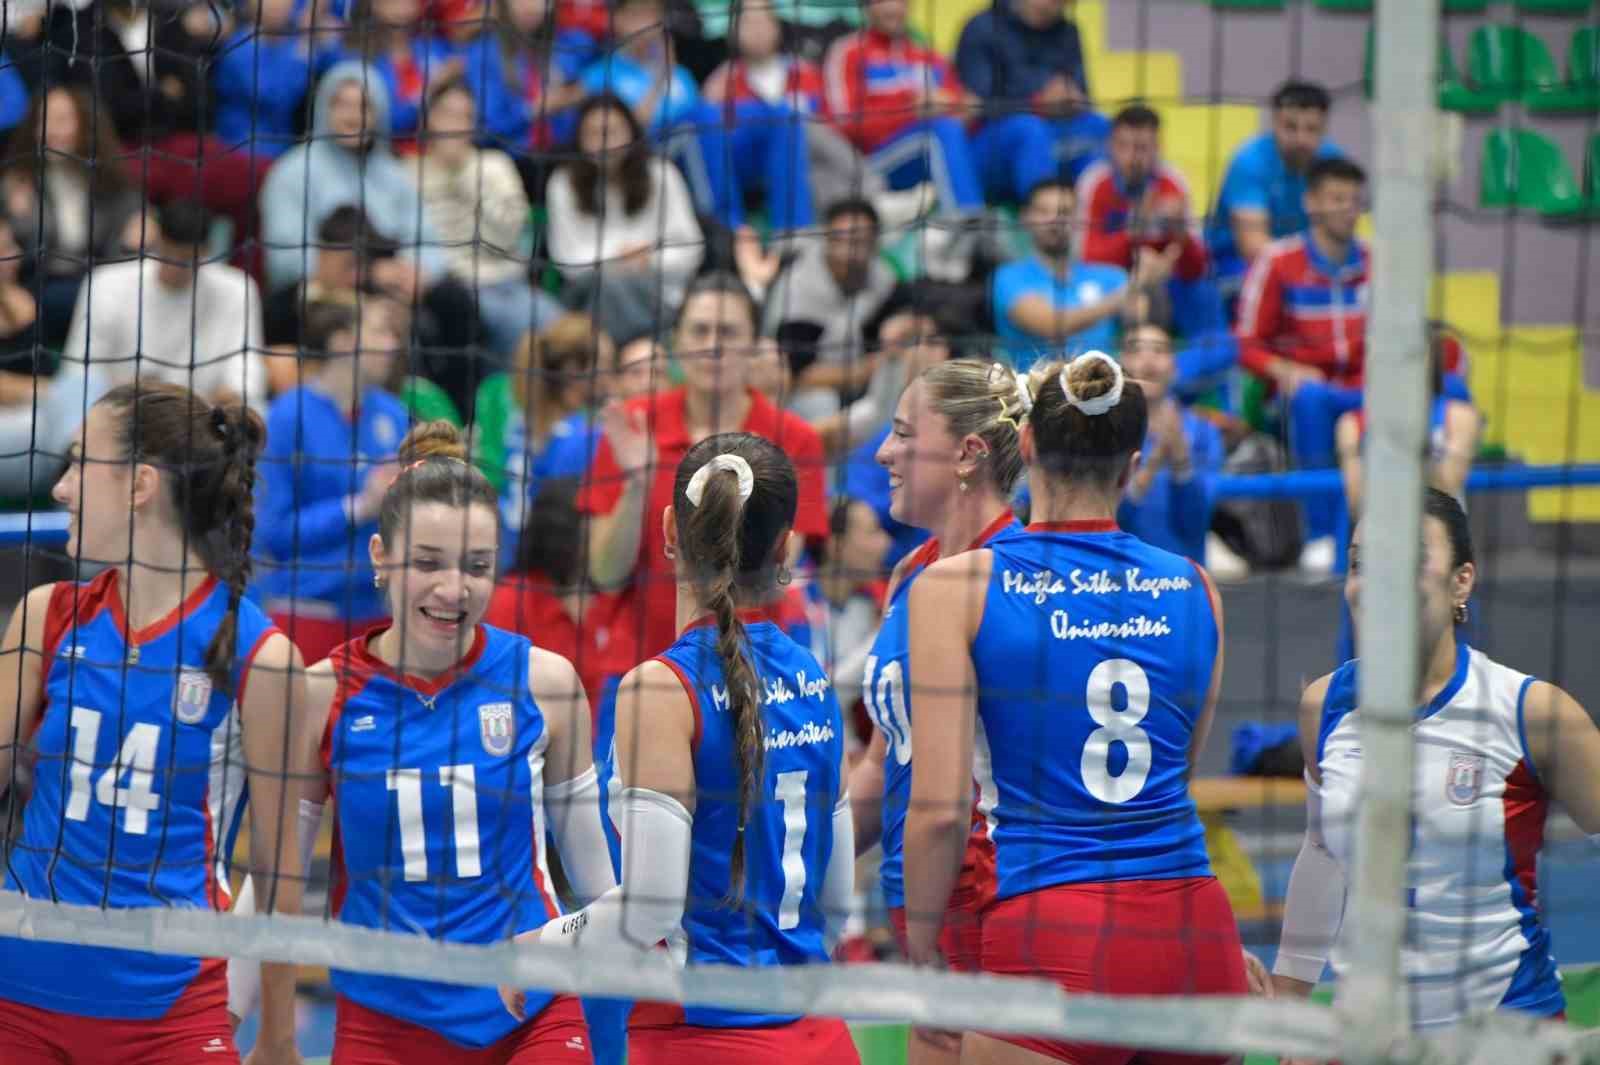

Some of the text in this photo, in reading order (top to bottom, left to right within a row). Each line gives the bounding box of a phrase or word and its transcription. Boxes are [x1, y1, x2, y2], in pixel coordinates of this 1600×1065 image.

[1002, 569, 1066, 605] Muğla
[1126, 567, 1192, 599] Koçman
[1050, 609, 1171, 640] Üniversitesi
[863, 655, 912, 766] 10
[1080, 658, 1152, 804] 8
[65, 706, 161, 835] 14
[386, 764, 482, 882] 11
[774, 770, 808, 930] 1
